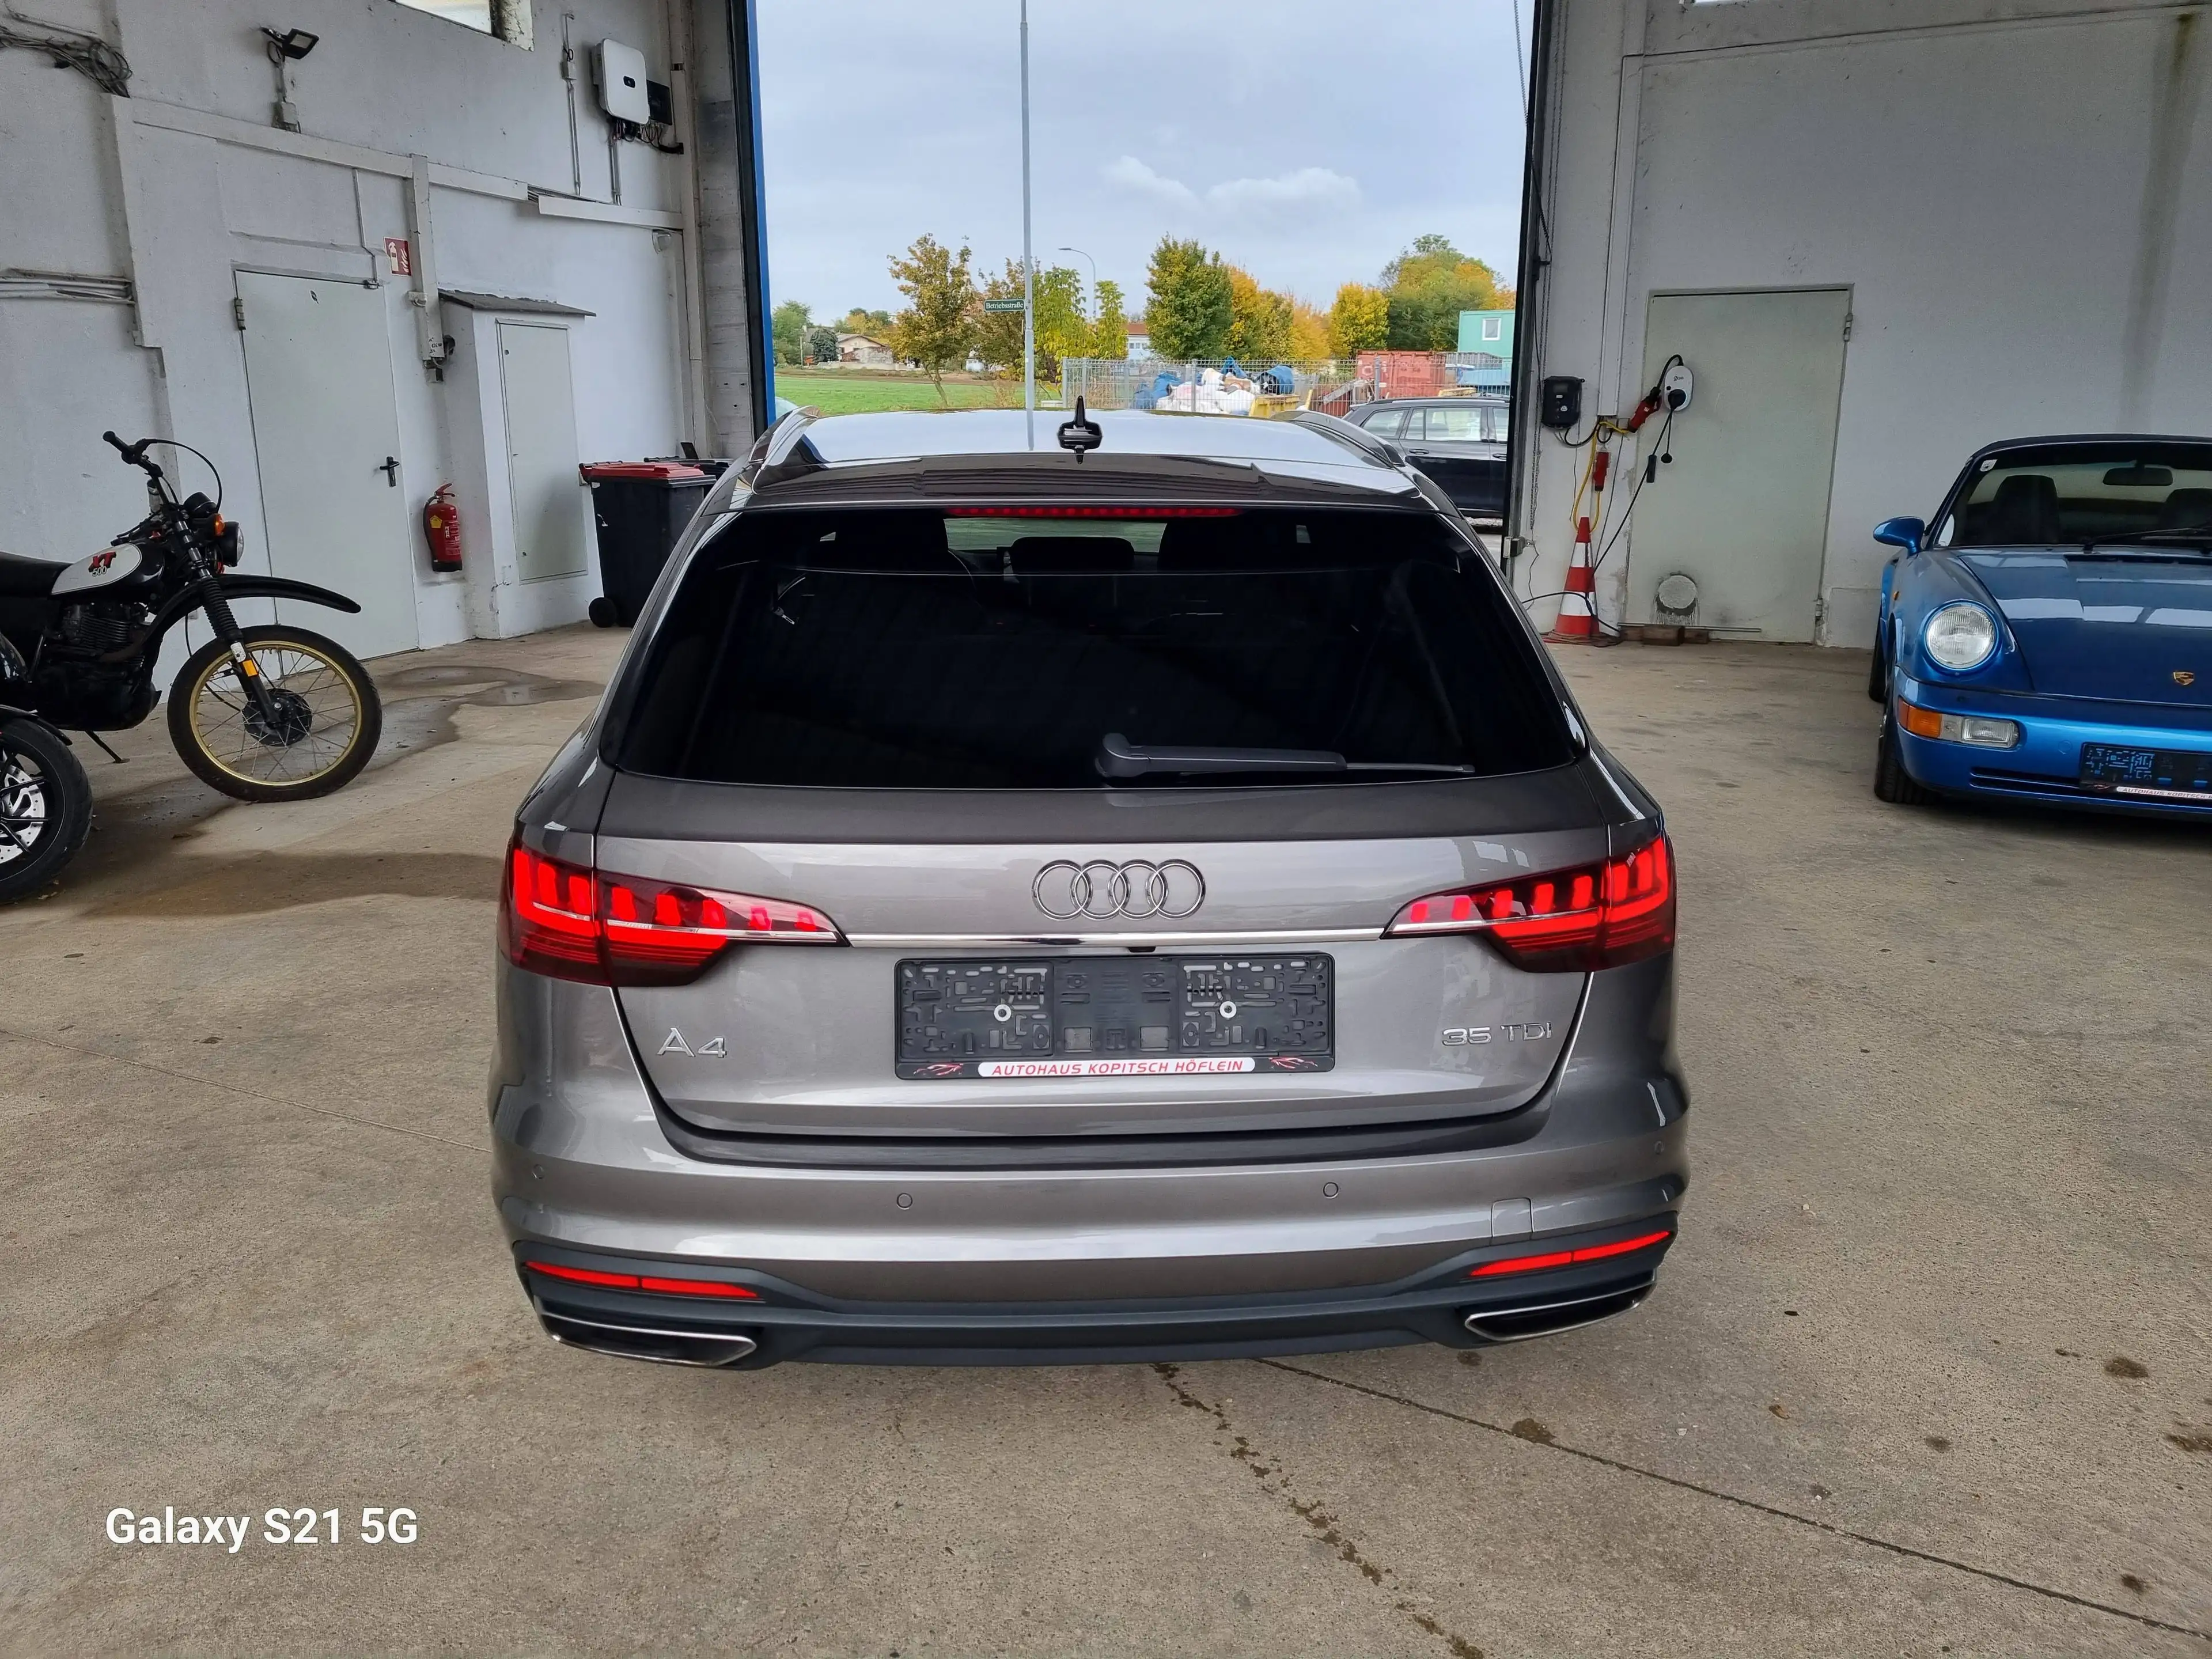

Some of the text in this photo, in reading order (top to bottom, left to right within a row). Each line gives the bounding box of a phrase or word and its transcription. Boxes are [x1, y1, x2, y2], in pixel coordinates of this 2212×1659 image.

[88, 551, 116, 573] XT
[92, 566, 107, 577] 500
[2123, 787, 2164, 796] AUTOHAUS
[1442, 1021, 1552, 1046] 35 TDI
[992, 1059, 1243, 1076] AUTOHAUS KOPITSCH HÖFLEIN
